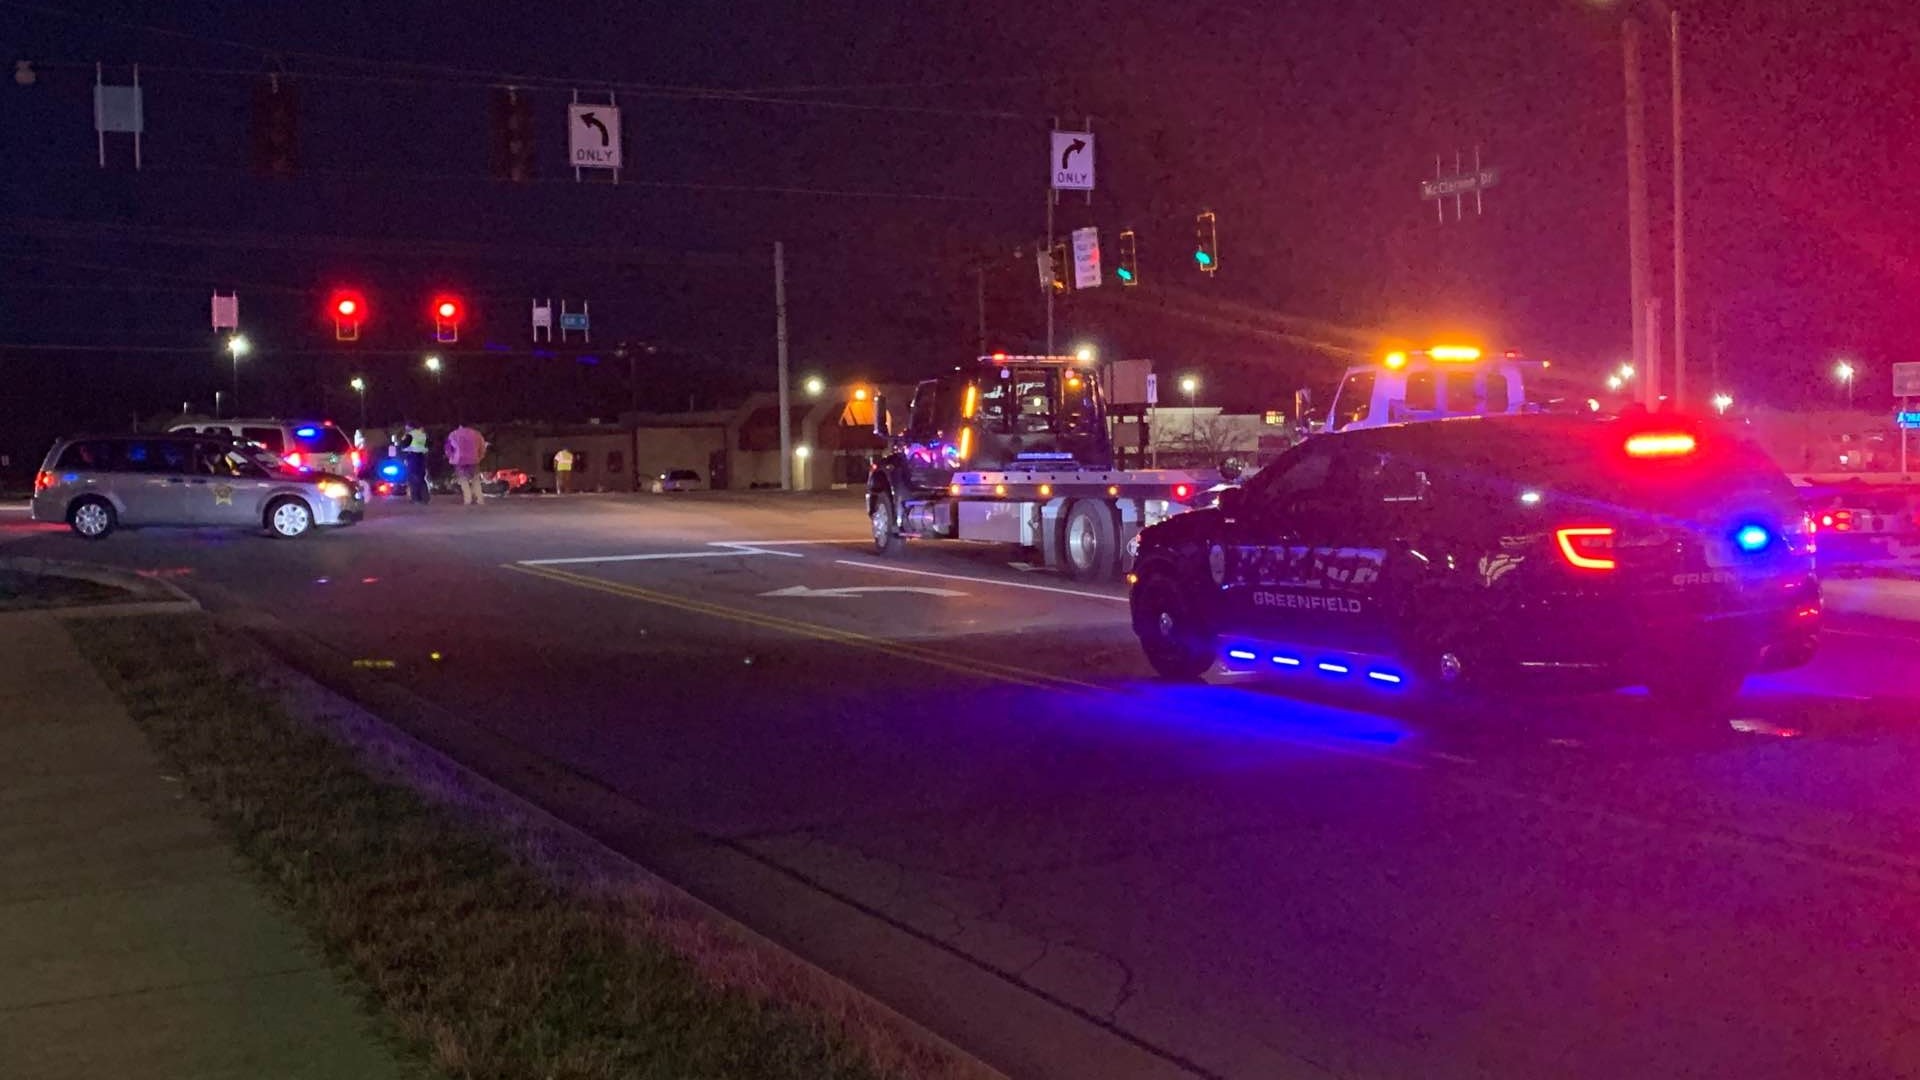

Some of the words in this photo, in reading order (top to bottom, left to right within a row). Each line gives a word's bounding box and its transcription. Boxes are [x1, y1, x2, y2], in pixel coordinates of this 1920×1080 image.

[577, 148, 613, 161] ONLY
[1058, 172, 1088, 184] ONLY
[1252, 591, 1362, 614] GREENFIELD
